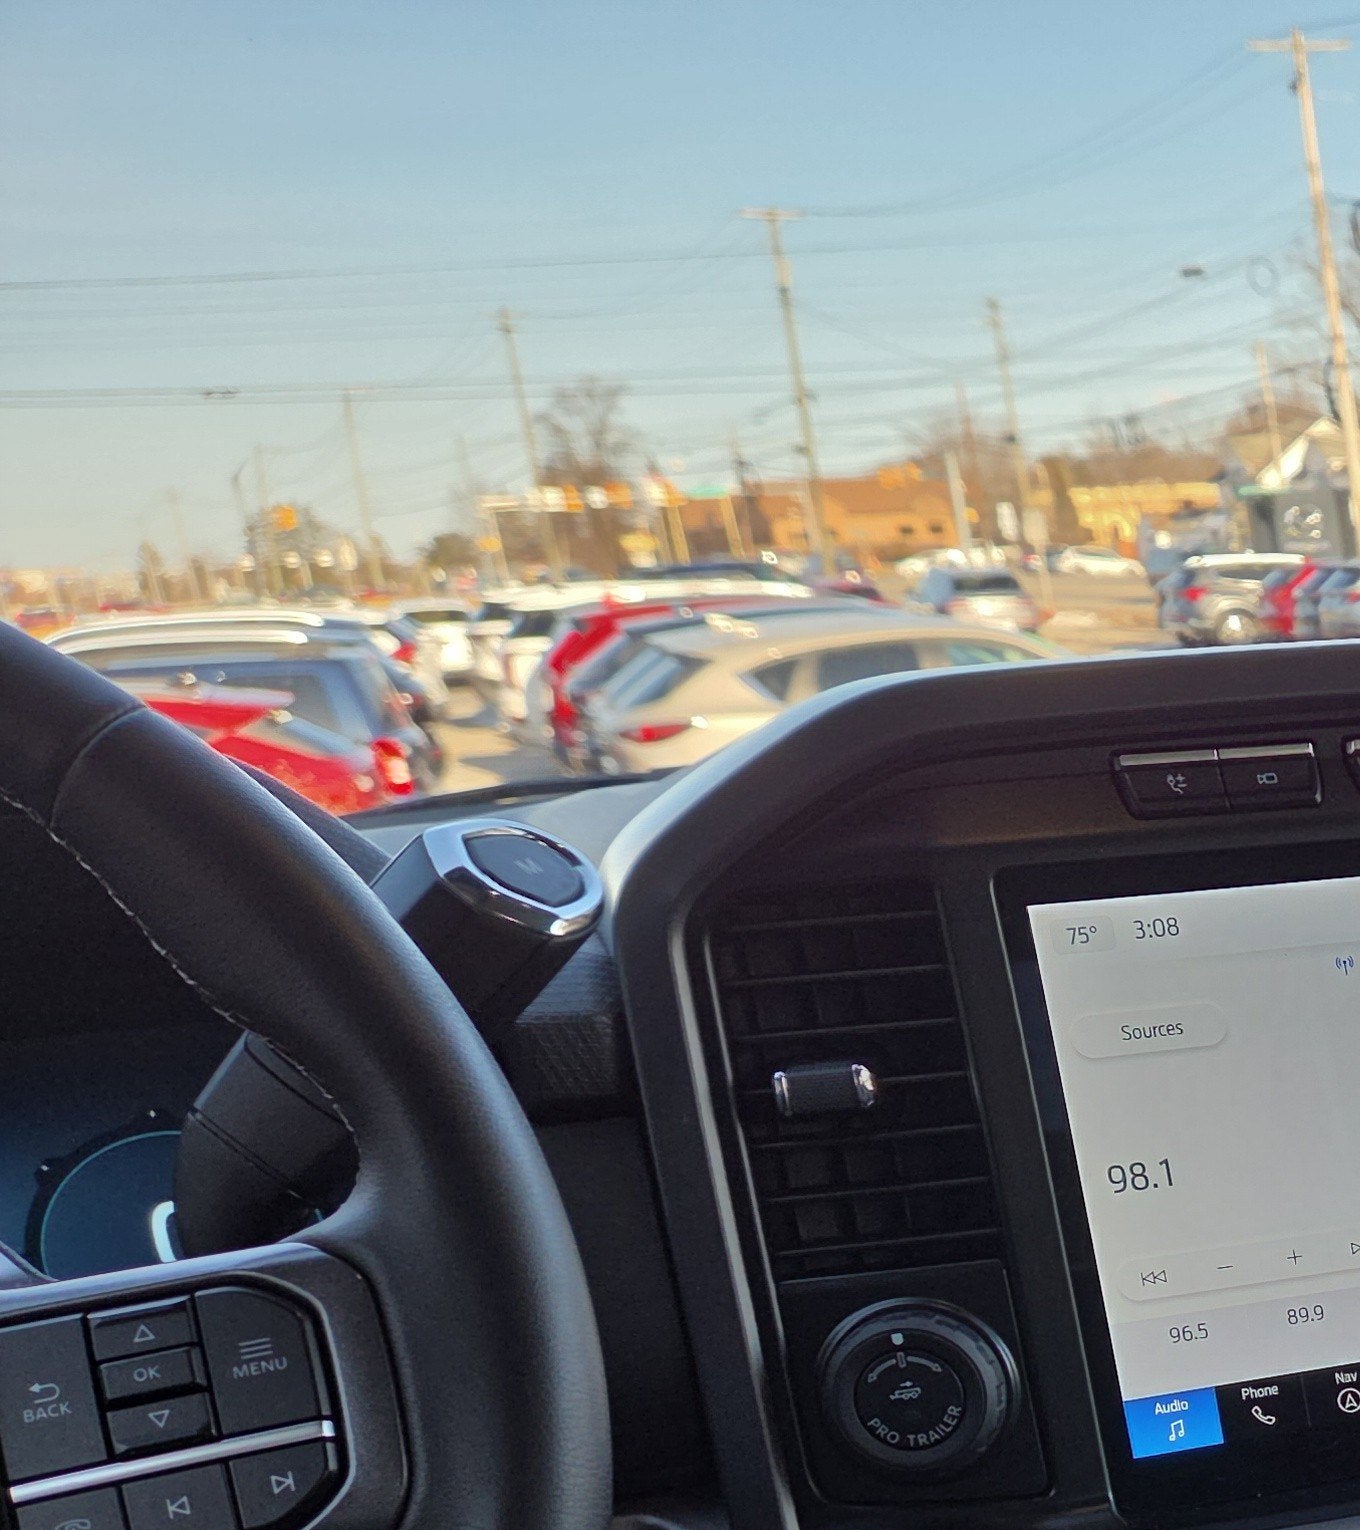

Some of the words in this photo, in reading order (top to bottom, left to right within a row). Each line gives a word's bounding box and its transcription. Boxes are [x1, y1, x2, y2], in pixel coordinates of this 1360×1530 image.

[1133, 917, 1180, 940] 3:08
[1120, 1019, 1184, 1041] Sources
[1107, 1157, 1175, 1195] 98.1
[1287, 1304, 1325, 1325] 89.9
[1169, 1322, 1209, 1344] 96.5
[132, 1365, 161, 1383] OK
[232, 1356, 288, 1380] MENU
[1335, 1370, 1358, 1385] Nav
[1241, 1383, 1279, 1400] Phone
[22, 1401, 73, 1424] BACK
[1154, 1398, 1189, 1415] Audio
[867, 1416, 900, 1445] PRO
[906, 1404, 963, 1448] TRAILER
